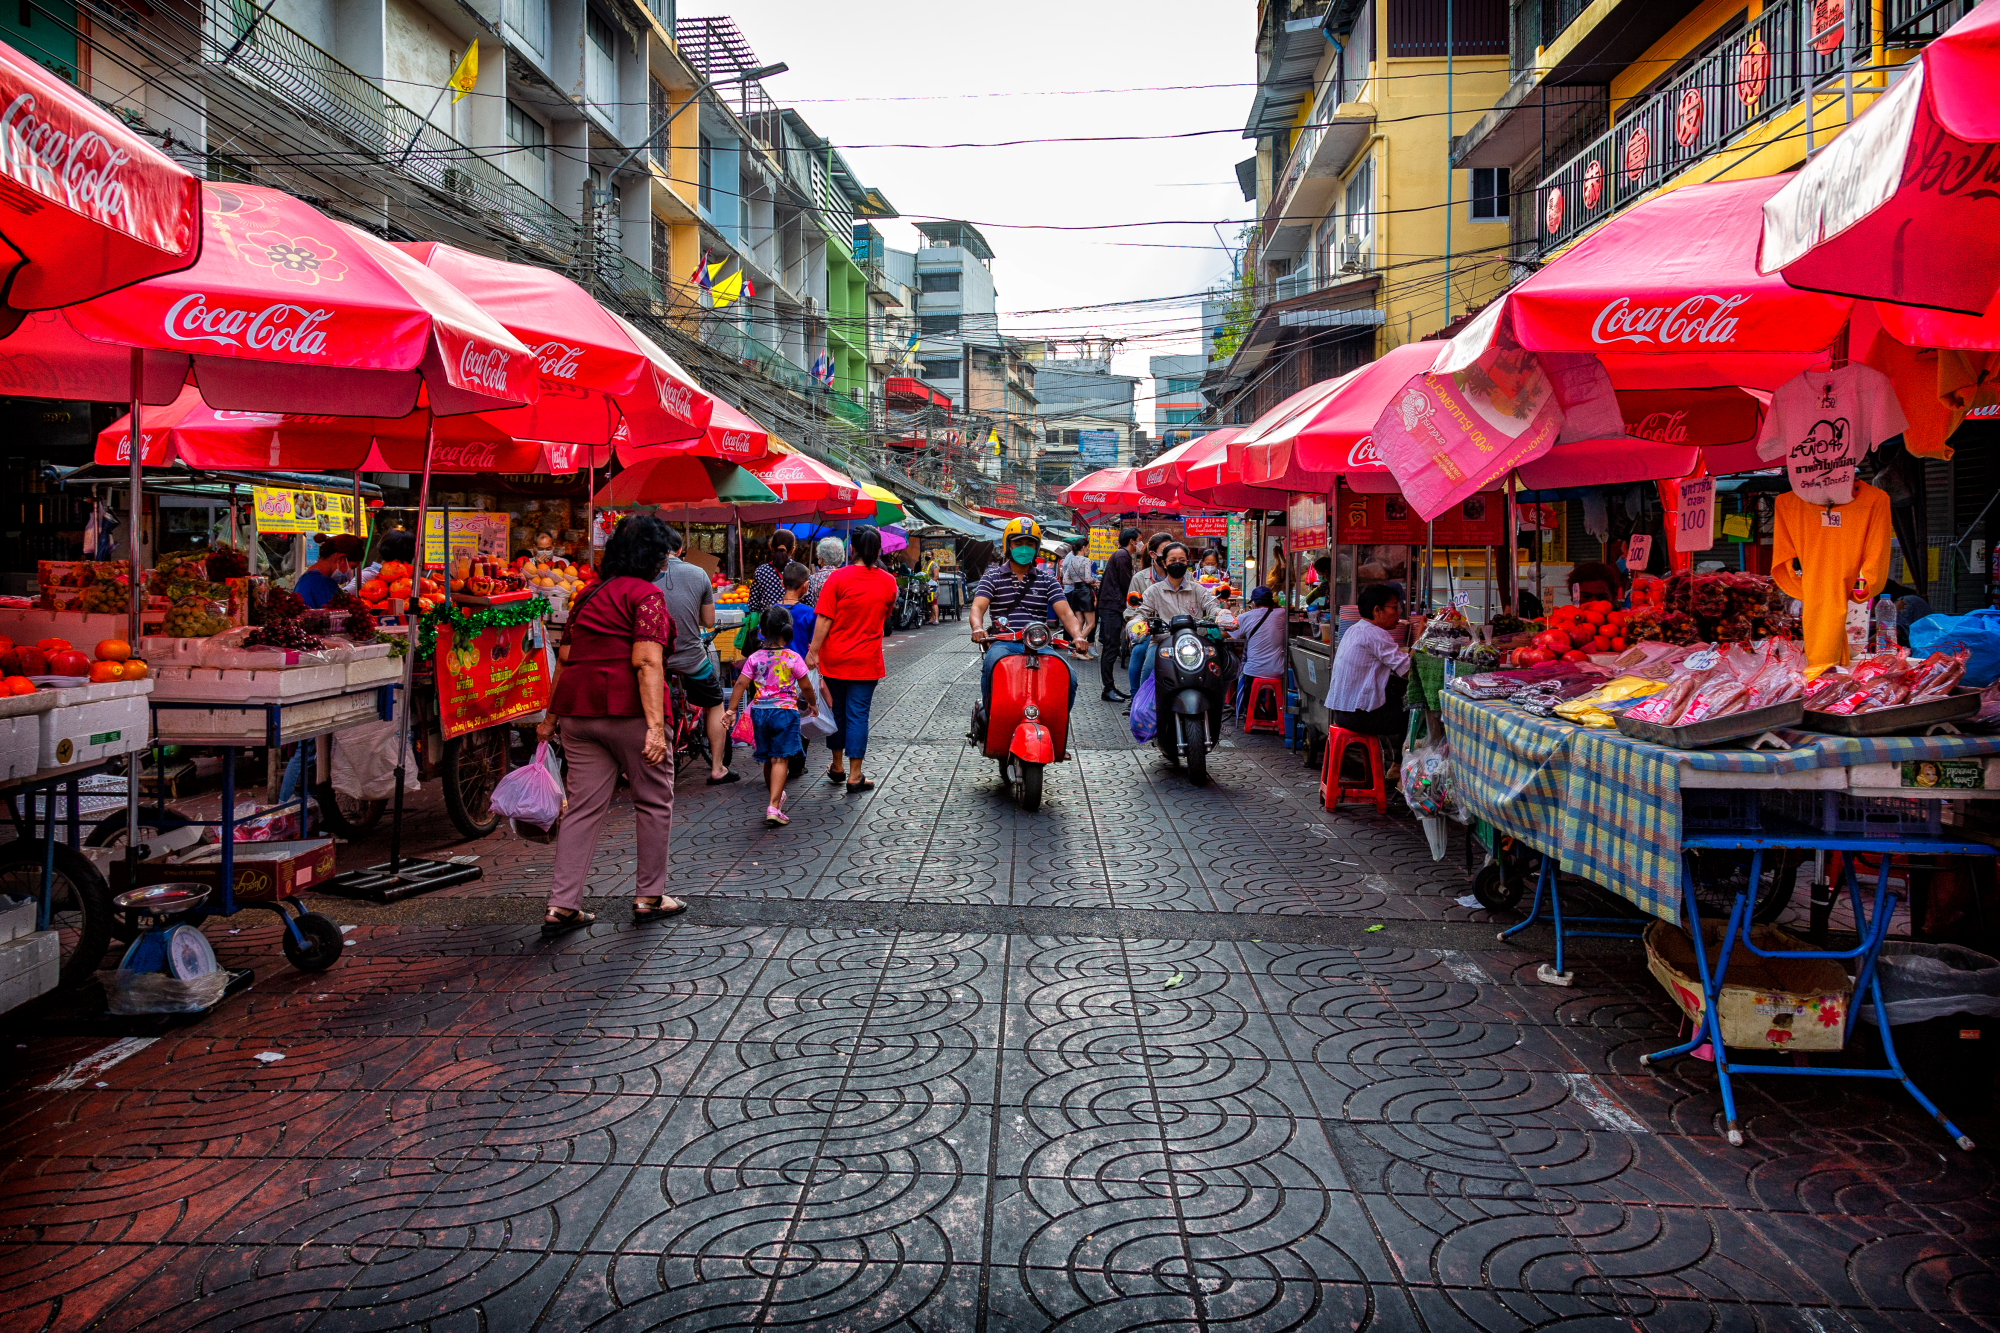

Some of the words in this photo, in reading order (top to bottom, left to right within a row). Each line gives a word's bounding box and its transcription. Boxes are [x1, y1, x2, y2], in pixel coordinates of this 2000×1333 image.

[0, 93, 131, 215] Coca-Cola
[164, 294, 335, 354] Coca-Cola
[1591, 294, 1752, 345] Coca-Cola
[460, 340, 510, 391] Coca-Cola
[662, 377, 693, 419] Coca-Cola
[722, 431, 751, 452] Coca-Cola
[551, 443, 569, 469] Coca-Cola
[1083, 492, 1107, 502] Coca-Cola
[1138, 495, 1167, 506] Coca-Cola
[1682, 509, 1706, 530] 100
[1629, 547, 1645, 561] 100
[1946, 768, 1978, 778] Emerald
[1952, 776, 1974, 787] Green
